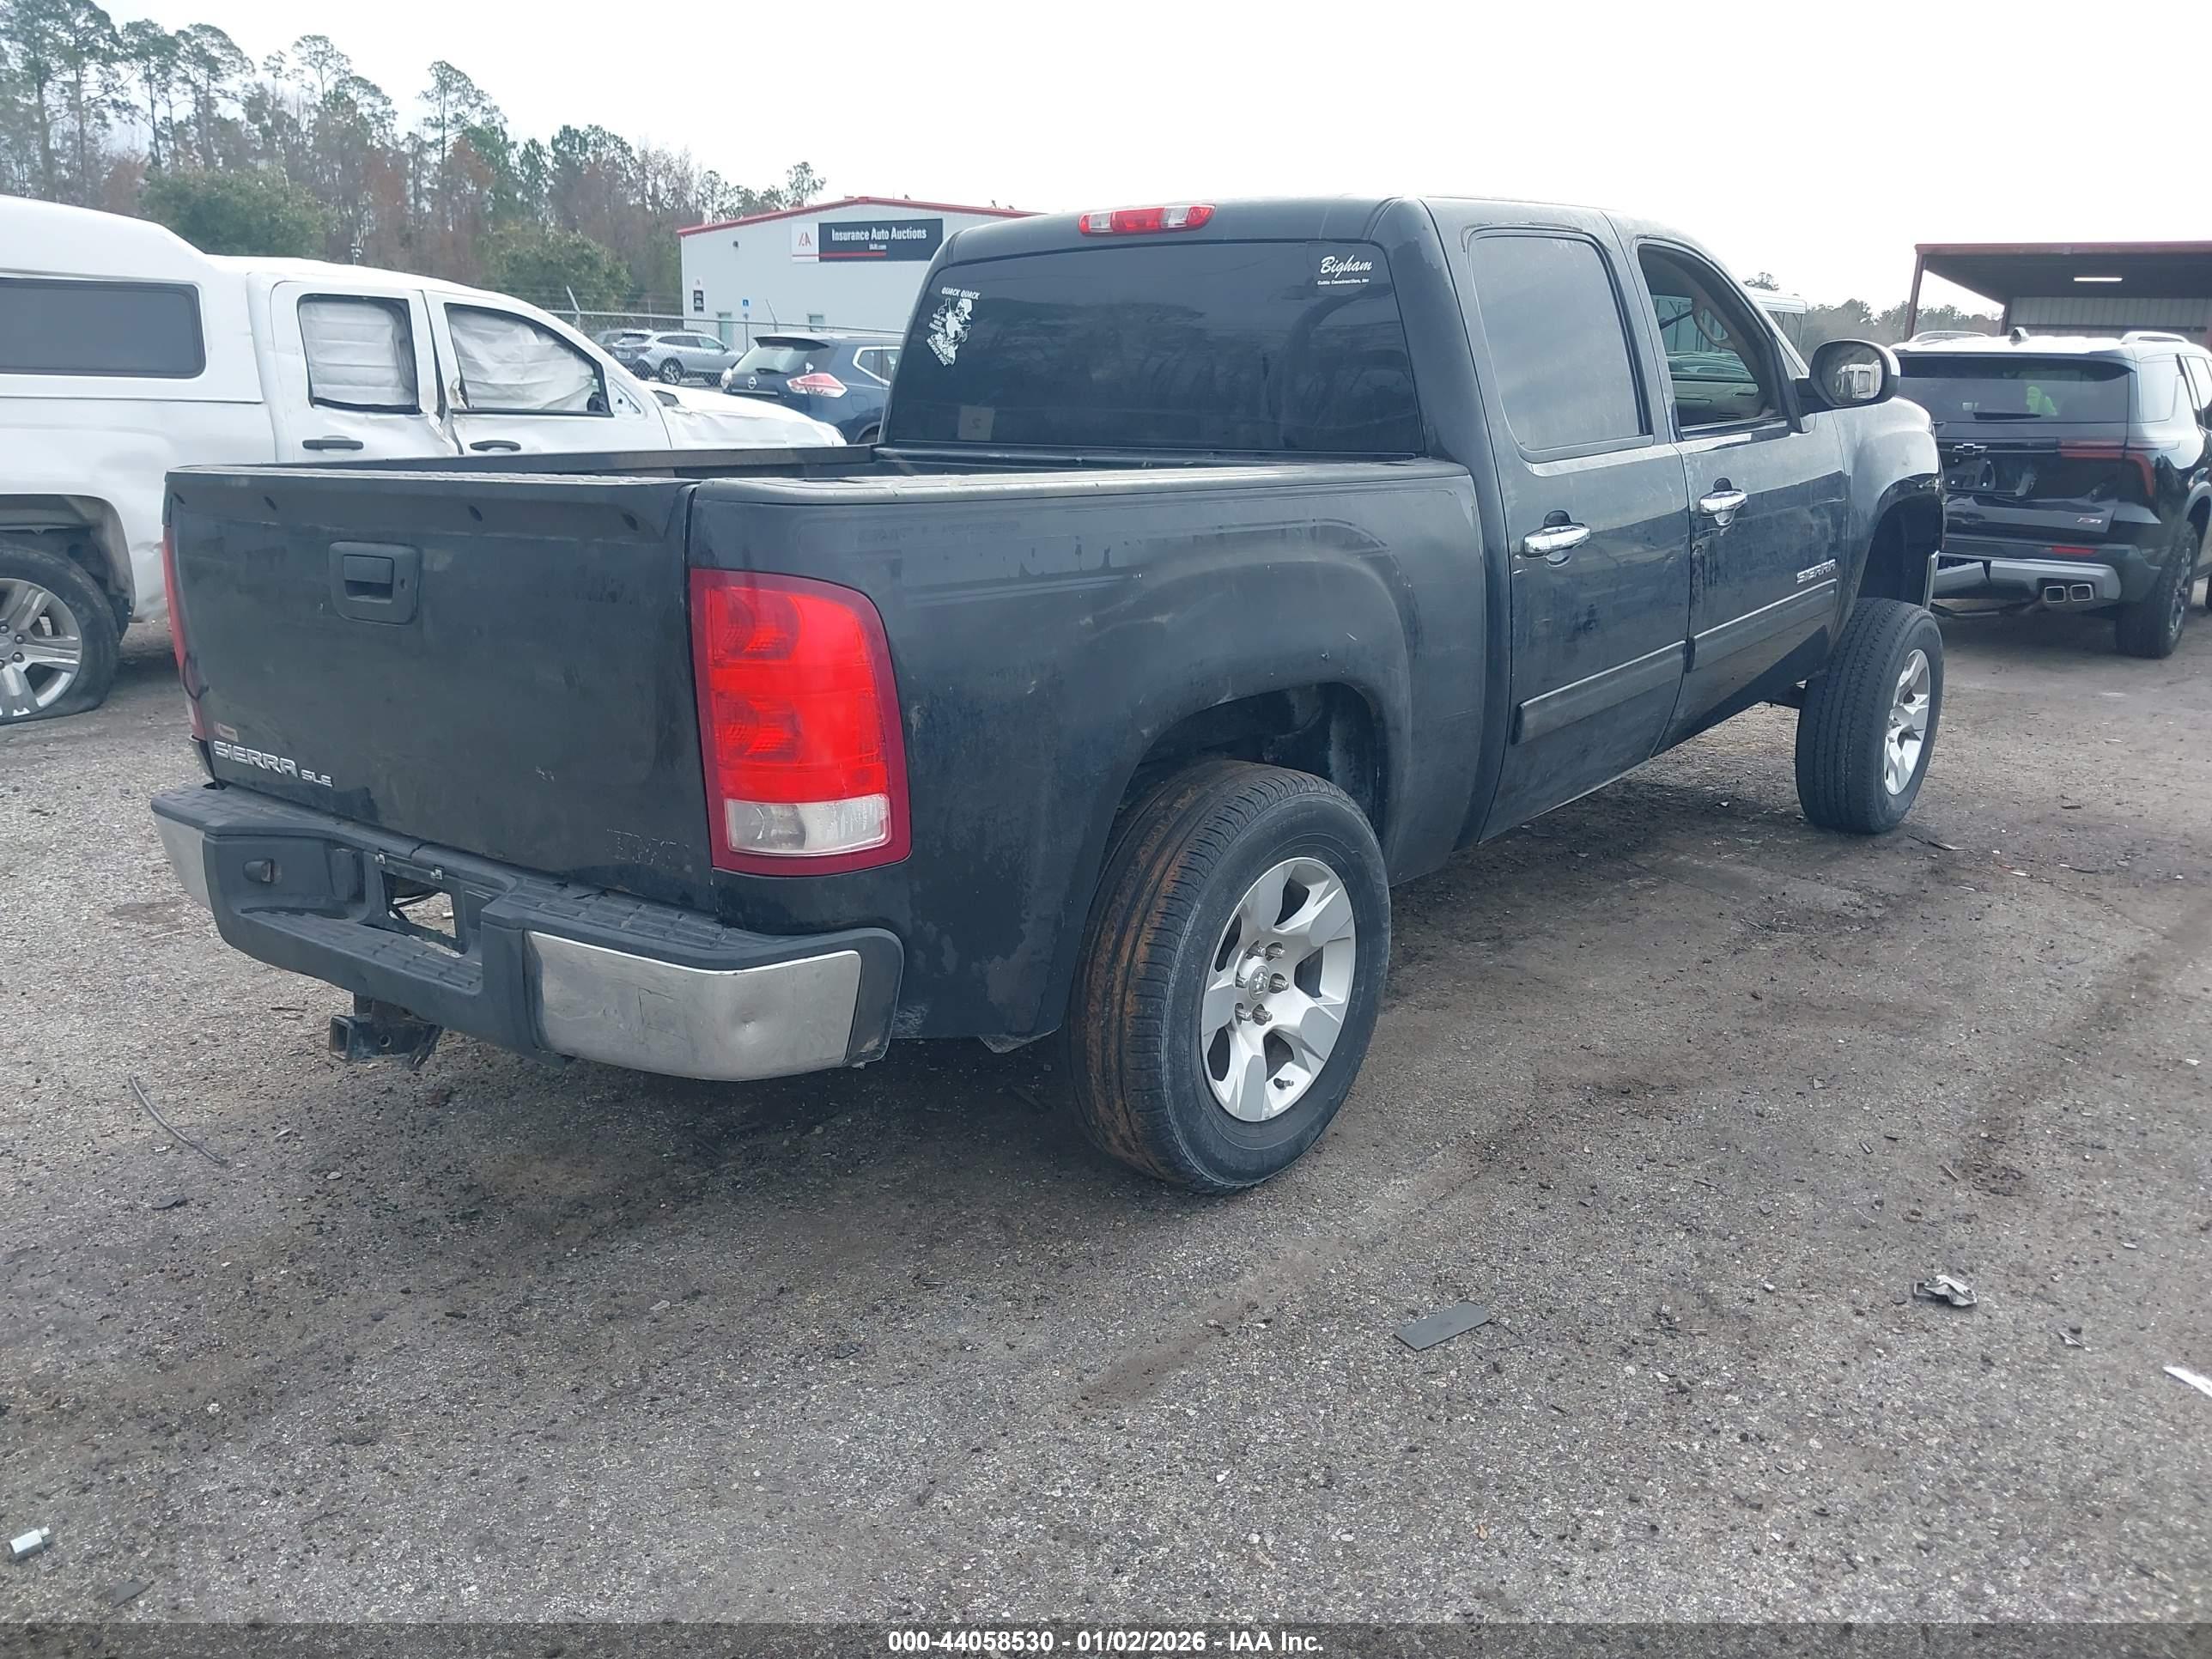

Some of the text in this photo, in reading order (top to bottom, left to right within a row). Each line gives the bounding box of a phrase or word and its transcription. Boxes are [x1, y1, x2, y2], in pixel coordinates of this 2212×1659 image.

[831, 226, 927, 242] Insurance Auto Auctions
[1320, 254, 1373, 279] Bigham
[941, 287, 981, 301] QUACK QUACK
[1796, 557, 1836, 585] SIERRA
[213, 740, 333, 788] SIERRA SLE
